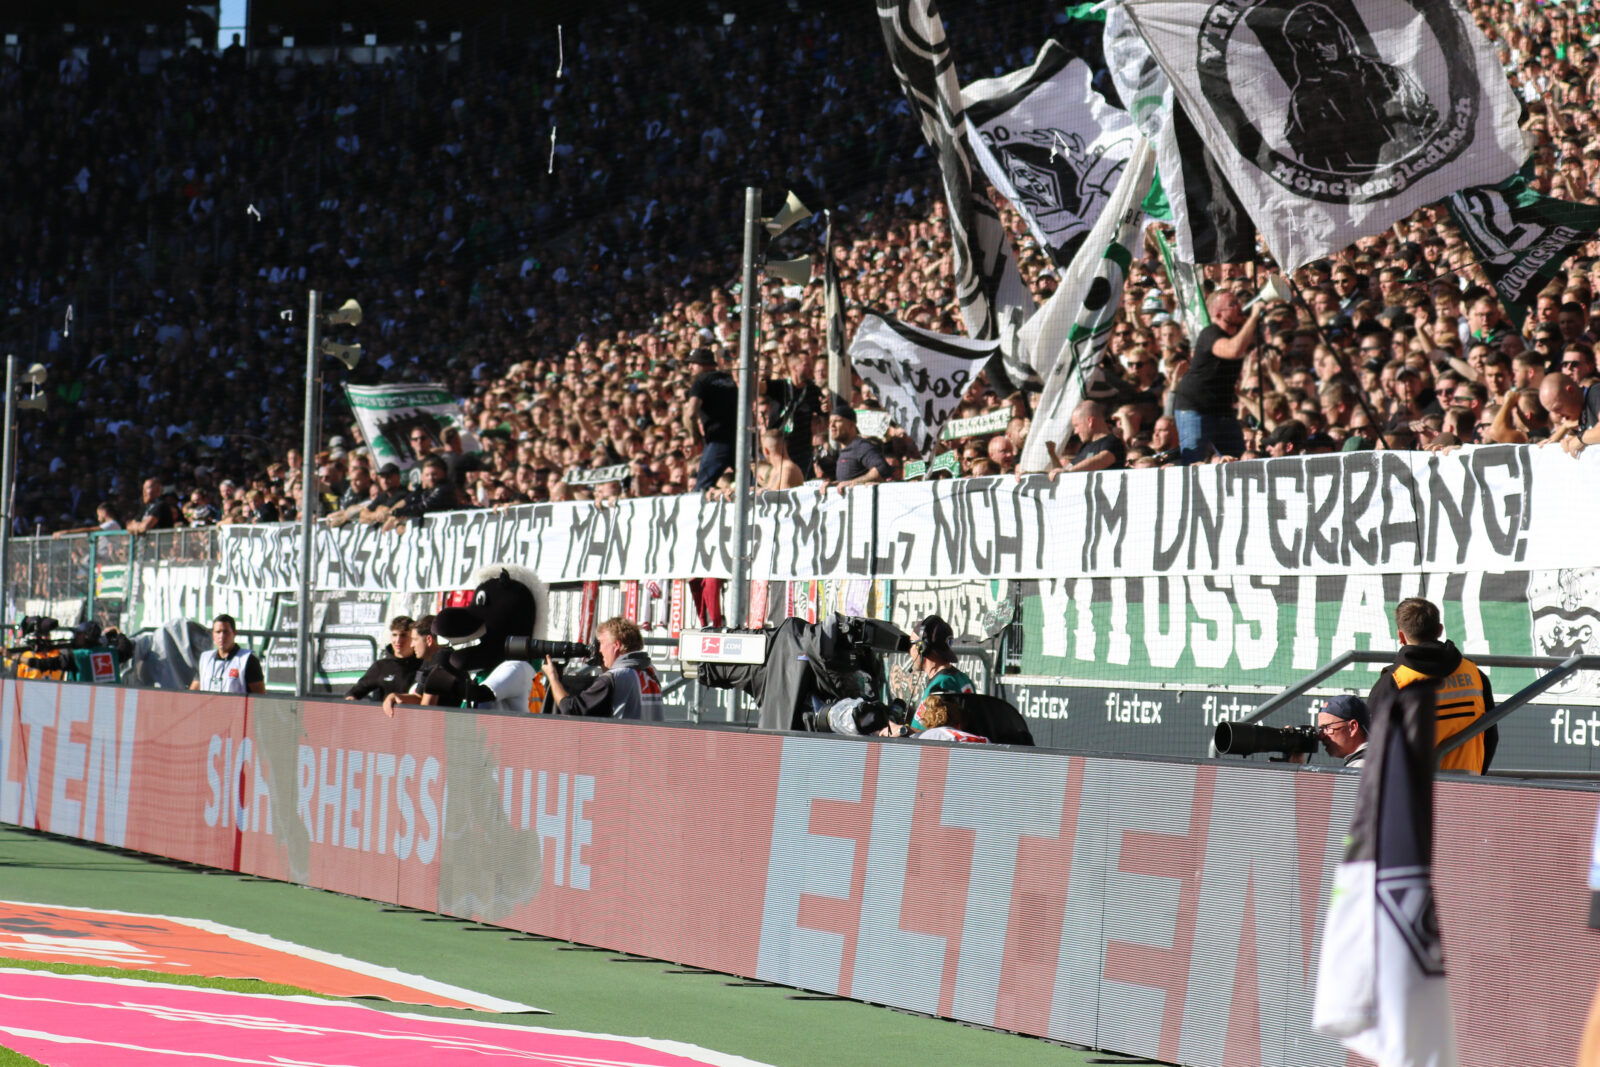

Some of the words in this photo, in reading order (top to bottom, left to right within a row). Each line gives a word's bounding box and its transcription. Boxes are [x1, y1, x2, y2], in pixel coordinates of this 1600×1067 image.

[1270, 97, 1472, 196] Mönchengladbach
[1495, 225, 1580, 302] BORUSSIA
[416, 504, 553, 590] ENTSORGT
[560, 501, 635, 579] MAN
[644, 496, 680, 575] IM
[929, 474, 1060, 577] NICHT
[1081, 471, 1129, 572] IM
[1152, 444, 1533, 573] UNTERRANG!
[755, 735, 1362, 1067] ELTEN
